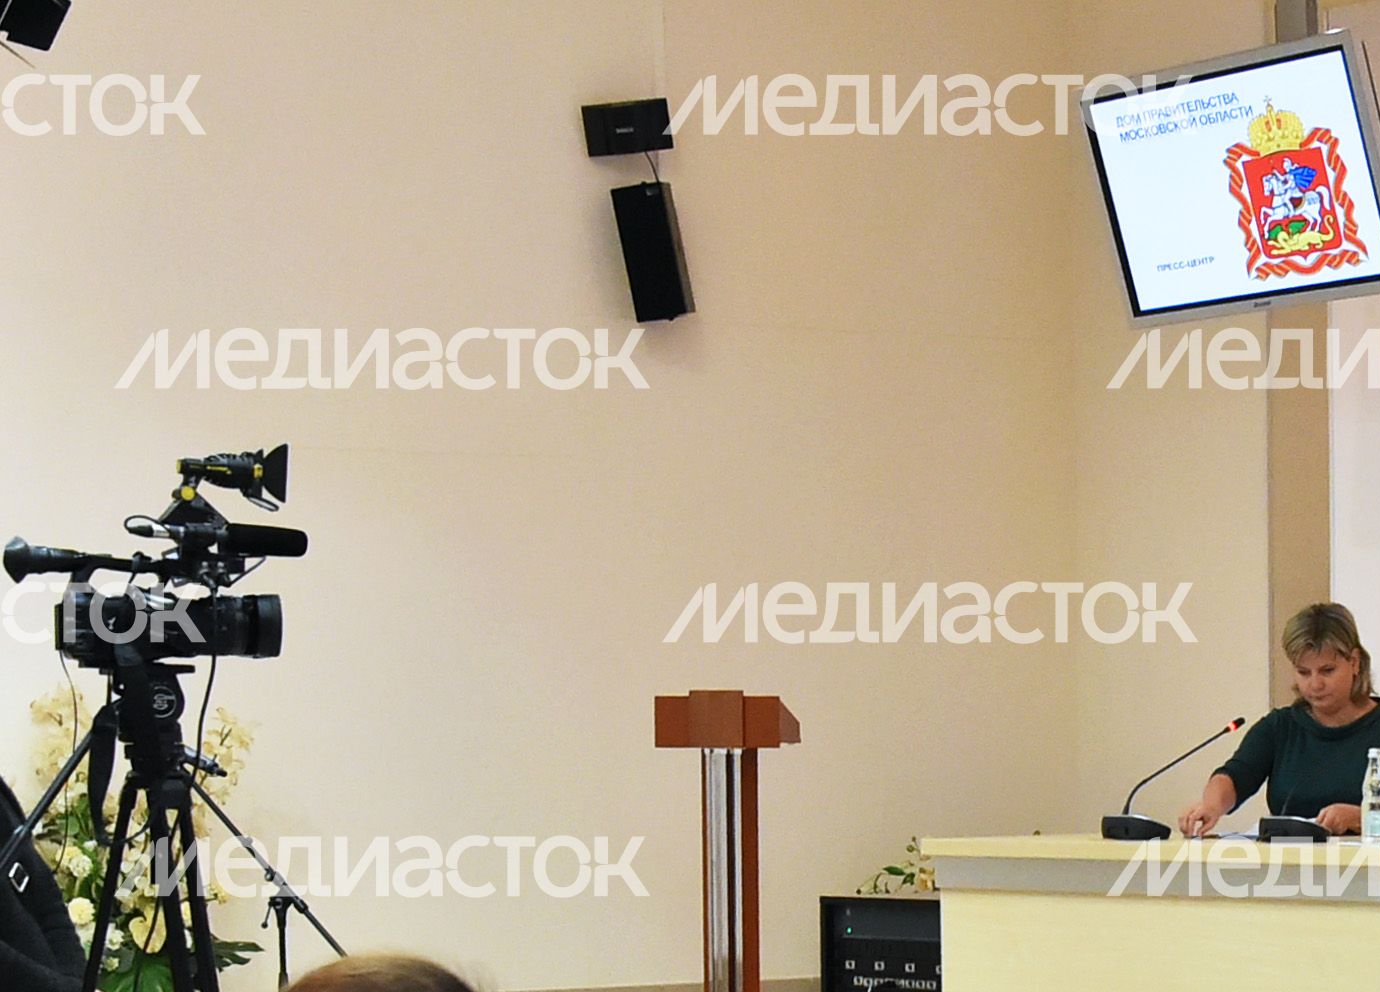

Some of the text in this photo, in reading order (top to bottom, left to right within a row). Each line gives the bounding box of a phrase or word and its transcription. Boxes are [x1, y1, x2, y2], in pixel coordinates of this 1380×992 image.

[1116, 92, 1240, 128] ДОМ ПРАВИТЕЛЬСТВА
[1119, 105, 1255, 143] МОСКОВСКОЙ ОБЛАСТИ
